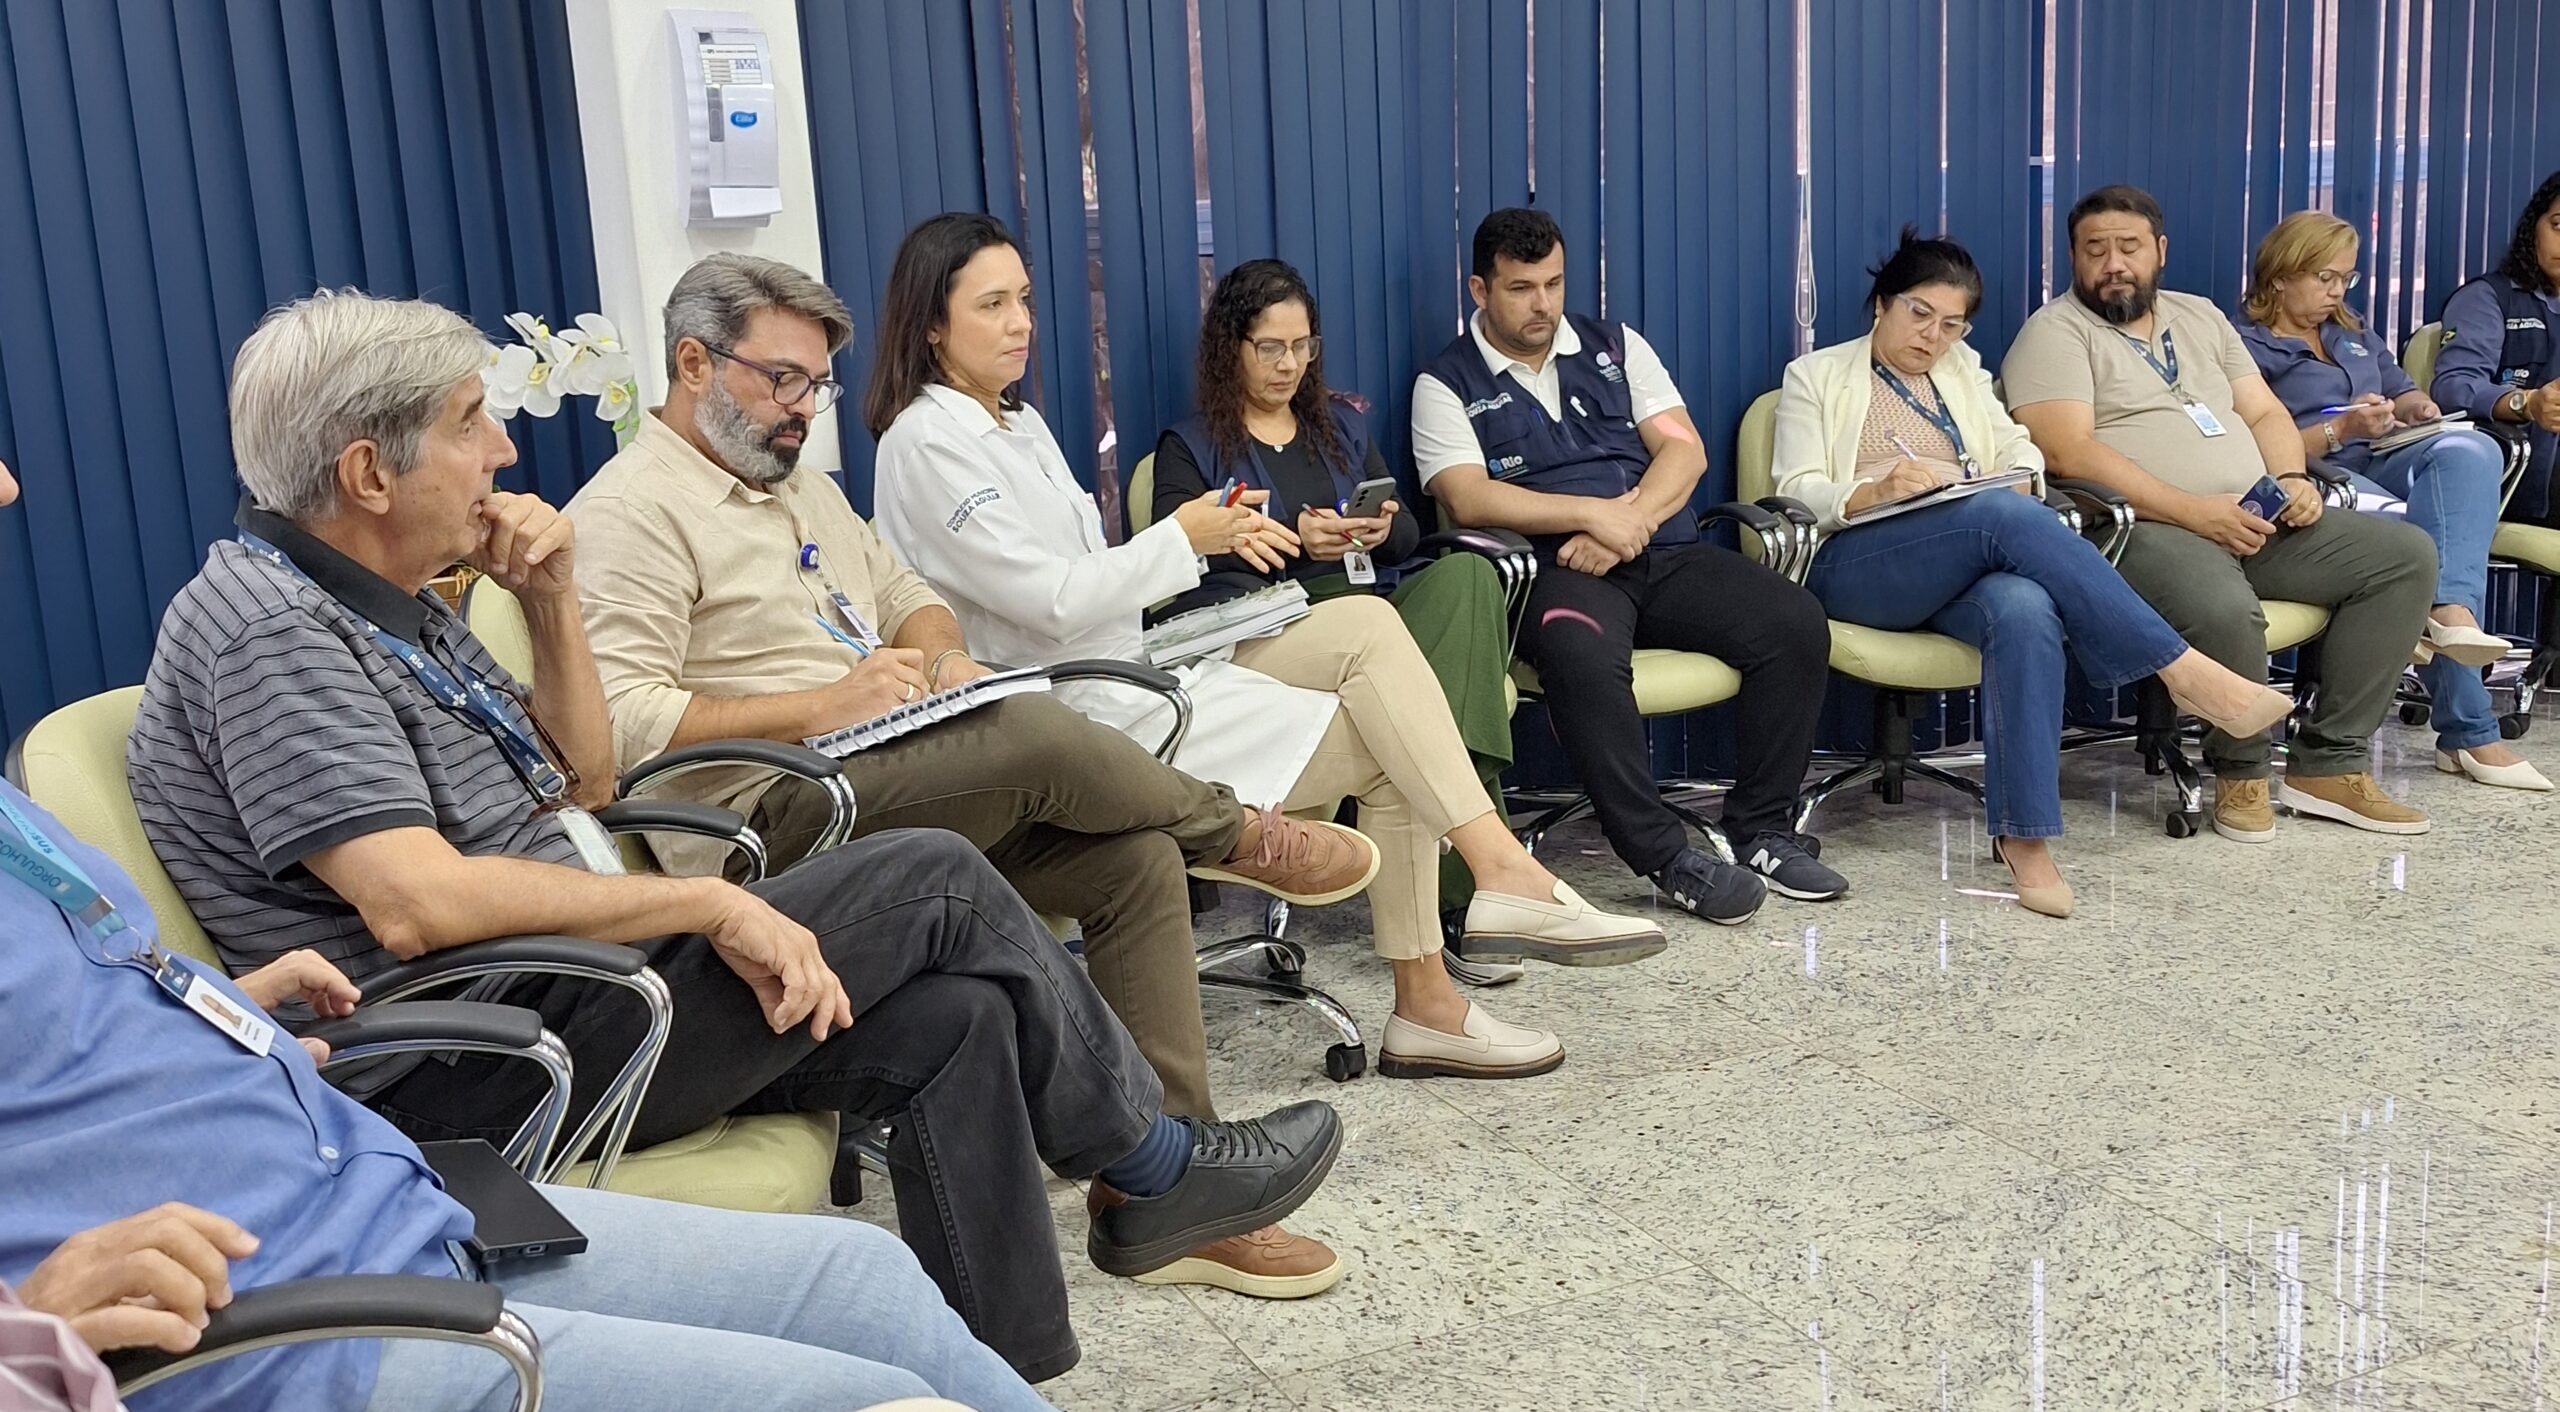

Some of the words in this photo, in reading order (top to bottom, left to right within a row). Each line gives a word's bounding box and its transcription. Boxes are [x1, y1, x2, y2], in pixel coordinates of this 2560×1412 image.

[1467, 403, 1488, 418] OUZA
[1500, 455, 1523, 470] Rio
[952, 505, 975, 533] SOUZA
[409, 653, 425, 670] Rio
[0, 841, 62, 888] ORGULHO
